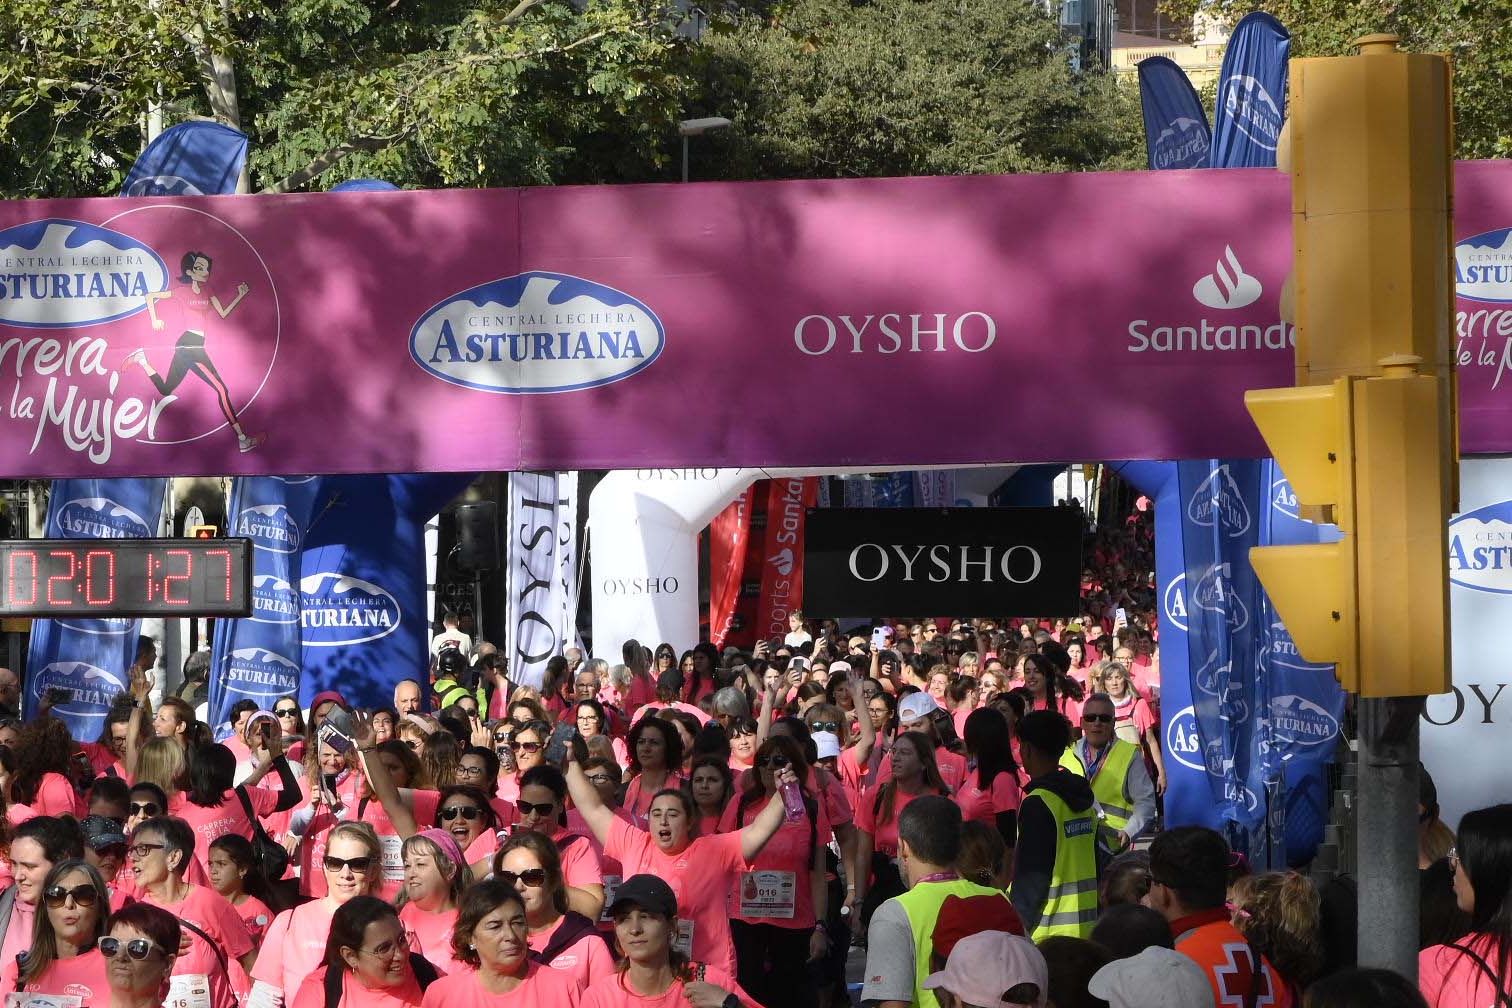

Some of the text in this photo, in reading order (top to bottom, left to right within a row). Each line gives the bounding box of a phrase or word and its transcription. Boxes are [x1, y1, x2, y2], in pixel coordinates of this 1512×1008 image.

[72, 255, 144, 267] LECHERA
[468, 312, 637, 327] CENTRAL LECHERA
[428, 319, 644, 364] ASTURIANA
[793, 311, 997, 356] OYSHO
[1477, 339, 1496, 366] la
[9, 388, 35, 419] la
[29, 369, 179, 465] Mujer
[848, 543, 1042, 586] OYSHO
[603, 576, 680, 595] OYSHO
[758, 888, 777, 897] 016
